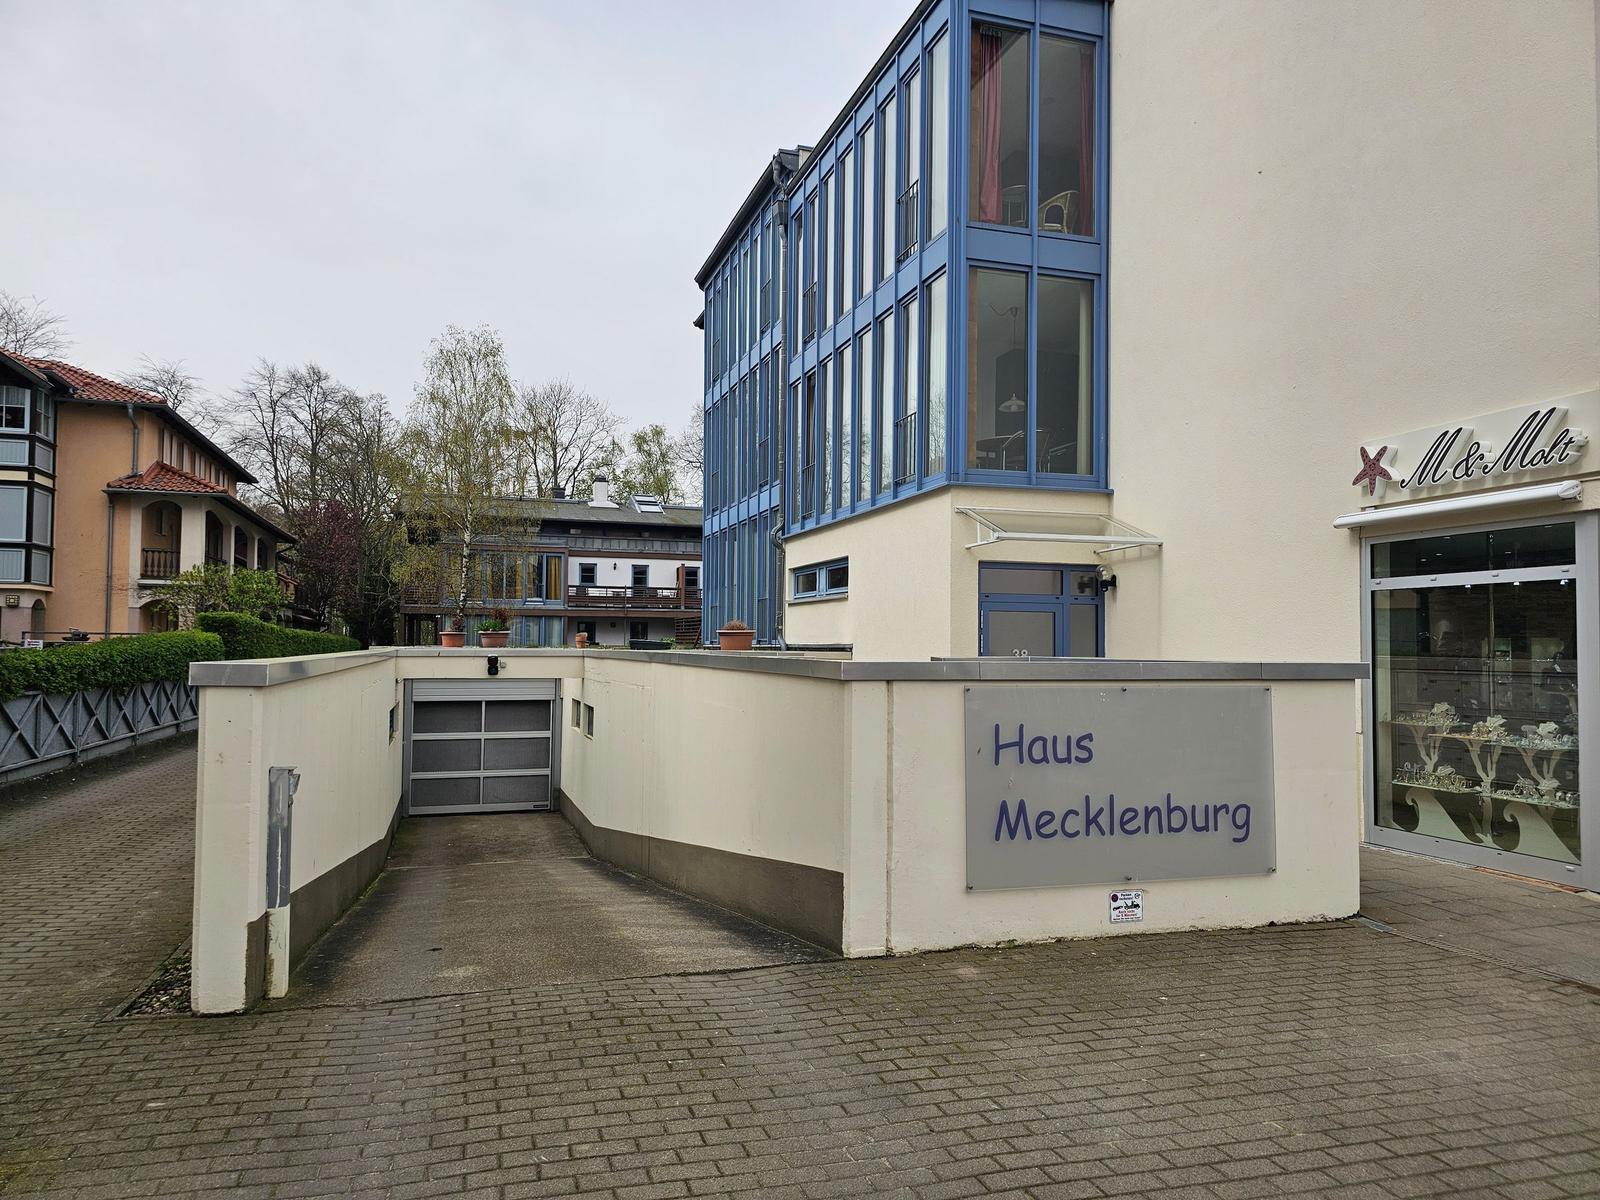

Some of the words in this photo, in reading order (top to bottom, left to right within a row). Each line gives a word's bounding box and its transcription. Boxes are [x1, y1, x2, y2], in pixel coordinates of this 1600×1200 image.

[1400, 427, 1463, 489] M
[1452, 441, 1485, 480] &
[994, 723, 1094, 766] Haus
[994, 793, 1251, 843] Mecklenburg
